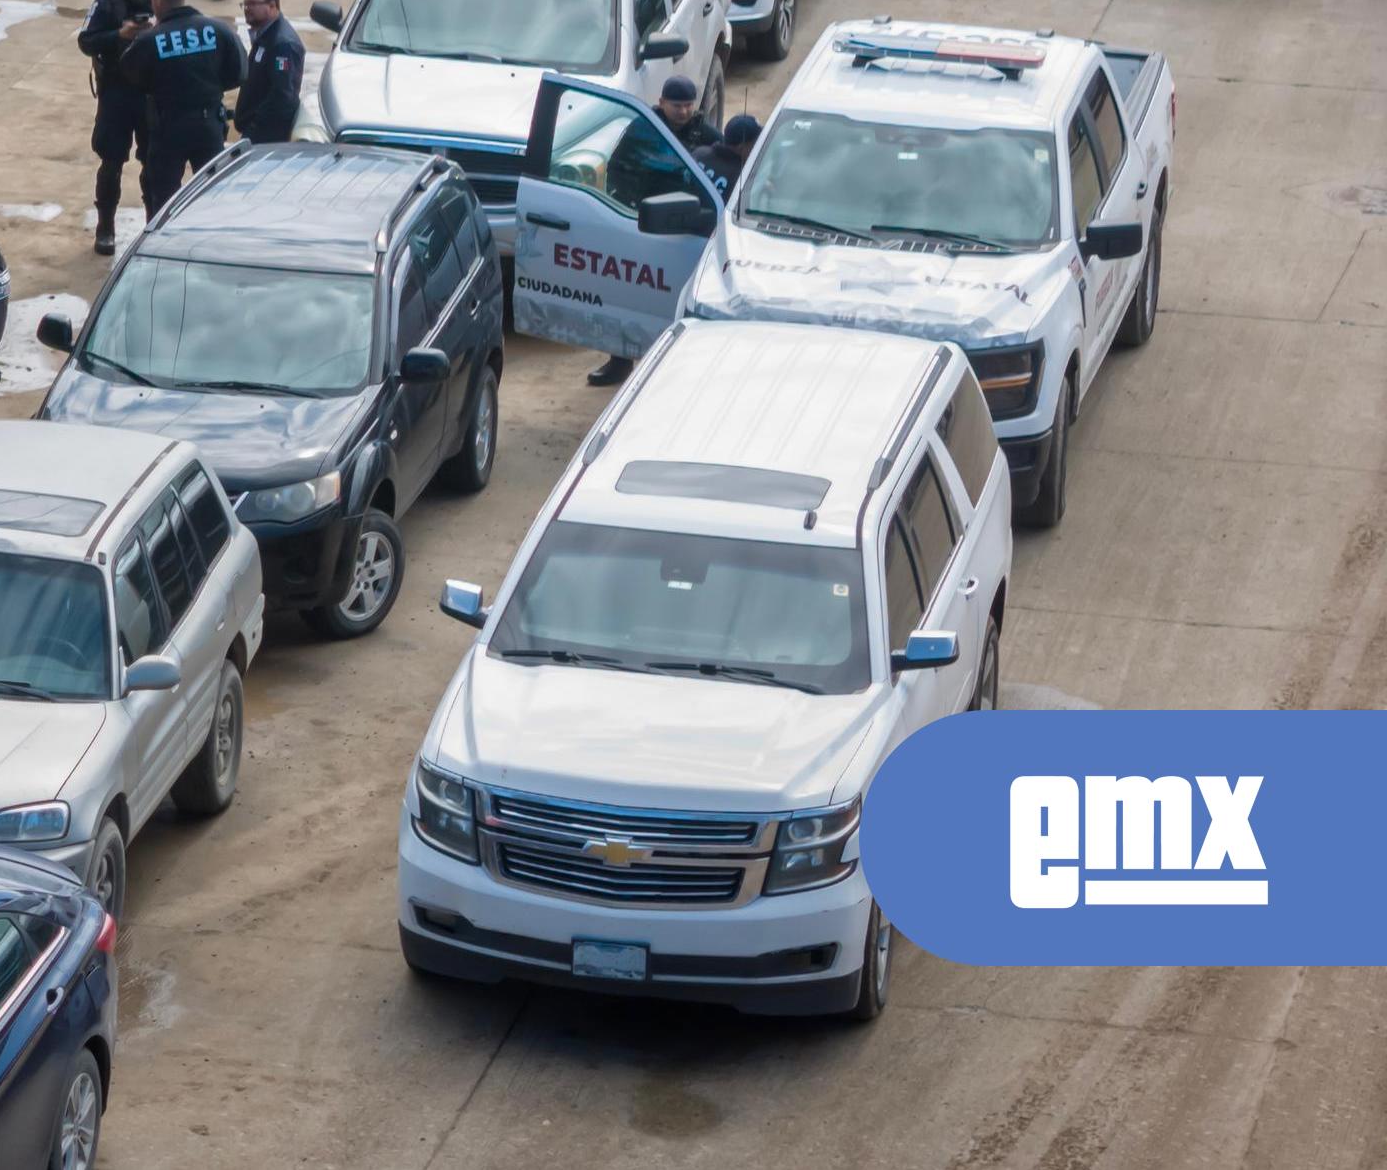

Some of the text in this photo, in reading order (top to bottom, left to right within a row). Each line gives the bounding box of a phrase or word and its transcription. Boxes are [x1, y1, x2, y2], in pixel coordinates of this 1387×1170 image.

[155, 25, 217, 55] FESC
[554, 242, 672, 293] ESTATAL
[517, 276, 604, 308] CIUDADANA
